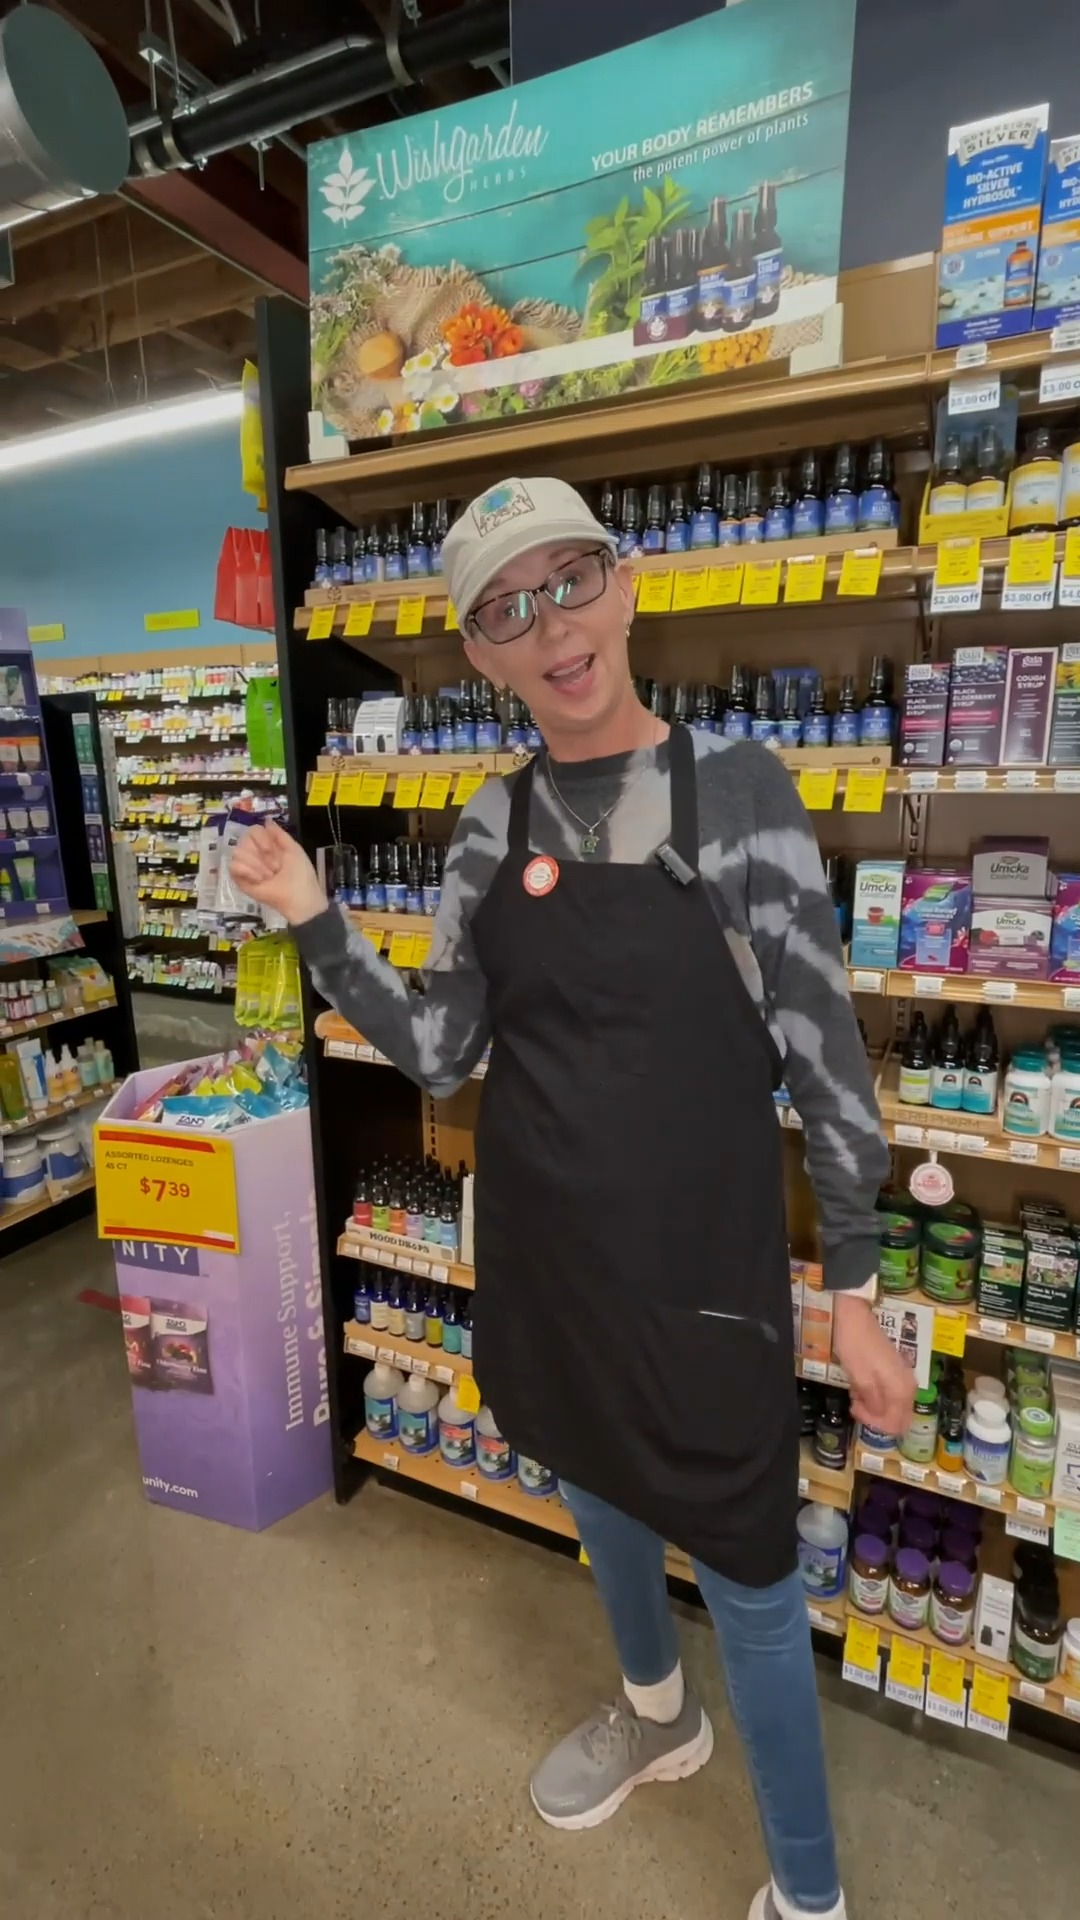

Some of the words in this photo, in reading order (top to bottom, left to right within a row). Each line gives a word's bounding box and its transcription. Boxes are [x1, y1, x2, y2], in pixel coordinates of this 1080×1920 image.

[591, 143, 637, 171] YOUR
[642, 124, 691, 156] BODY
[697, 81, 814, 138] REMEMBERS
[633, 166, 652, 183] the
[656, 150, 698, 178] potent
[703, 138, 742, 163] power
[747, 126, 762, 145] of
[765, 112, 809, 140] plants
[966, 129, 1030, 154] SILVER
[966, 162, 1023, 186] BIO-ACTIVE
[976, 177, 1010, 194] SILVER
[963, 187, 1017, 209] HYDROSOL
[979, 389, 998, 404] off
[961, 592, 979, 604] off
[1033, 591, 1053, 603] off
[1015, 674, 1046, 682] COUGH
[991, 862, 1030, 874] Umcka
[859, 882, 897, 893] Umcka
[996, 916, 1026, 926] Umcka
[105, 1151, 149, 1161] ASSORTED
[151, 1155, 194, 1167] LOZENGES
[369, 1231, 398, 1247] MOOD
[121, 1240, 189, 1265] NITY
[271, 1210, 299, 1323] Support,
[285, 1324, 305, 1431] Immune
[142, 1475, 198, 1499] unity.com
[1031, 1527, 1047, 1538] off
[864, 1673, 878, 1683] off
[908, 1690, 922, 1704] off
[949, 1706, 963, 1719] off
[991, 1720, 1006, 1733] off
